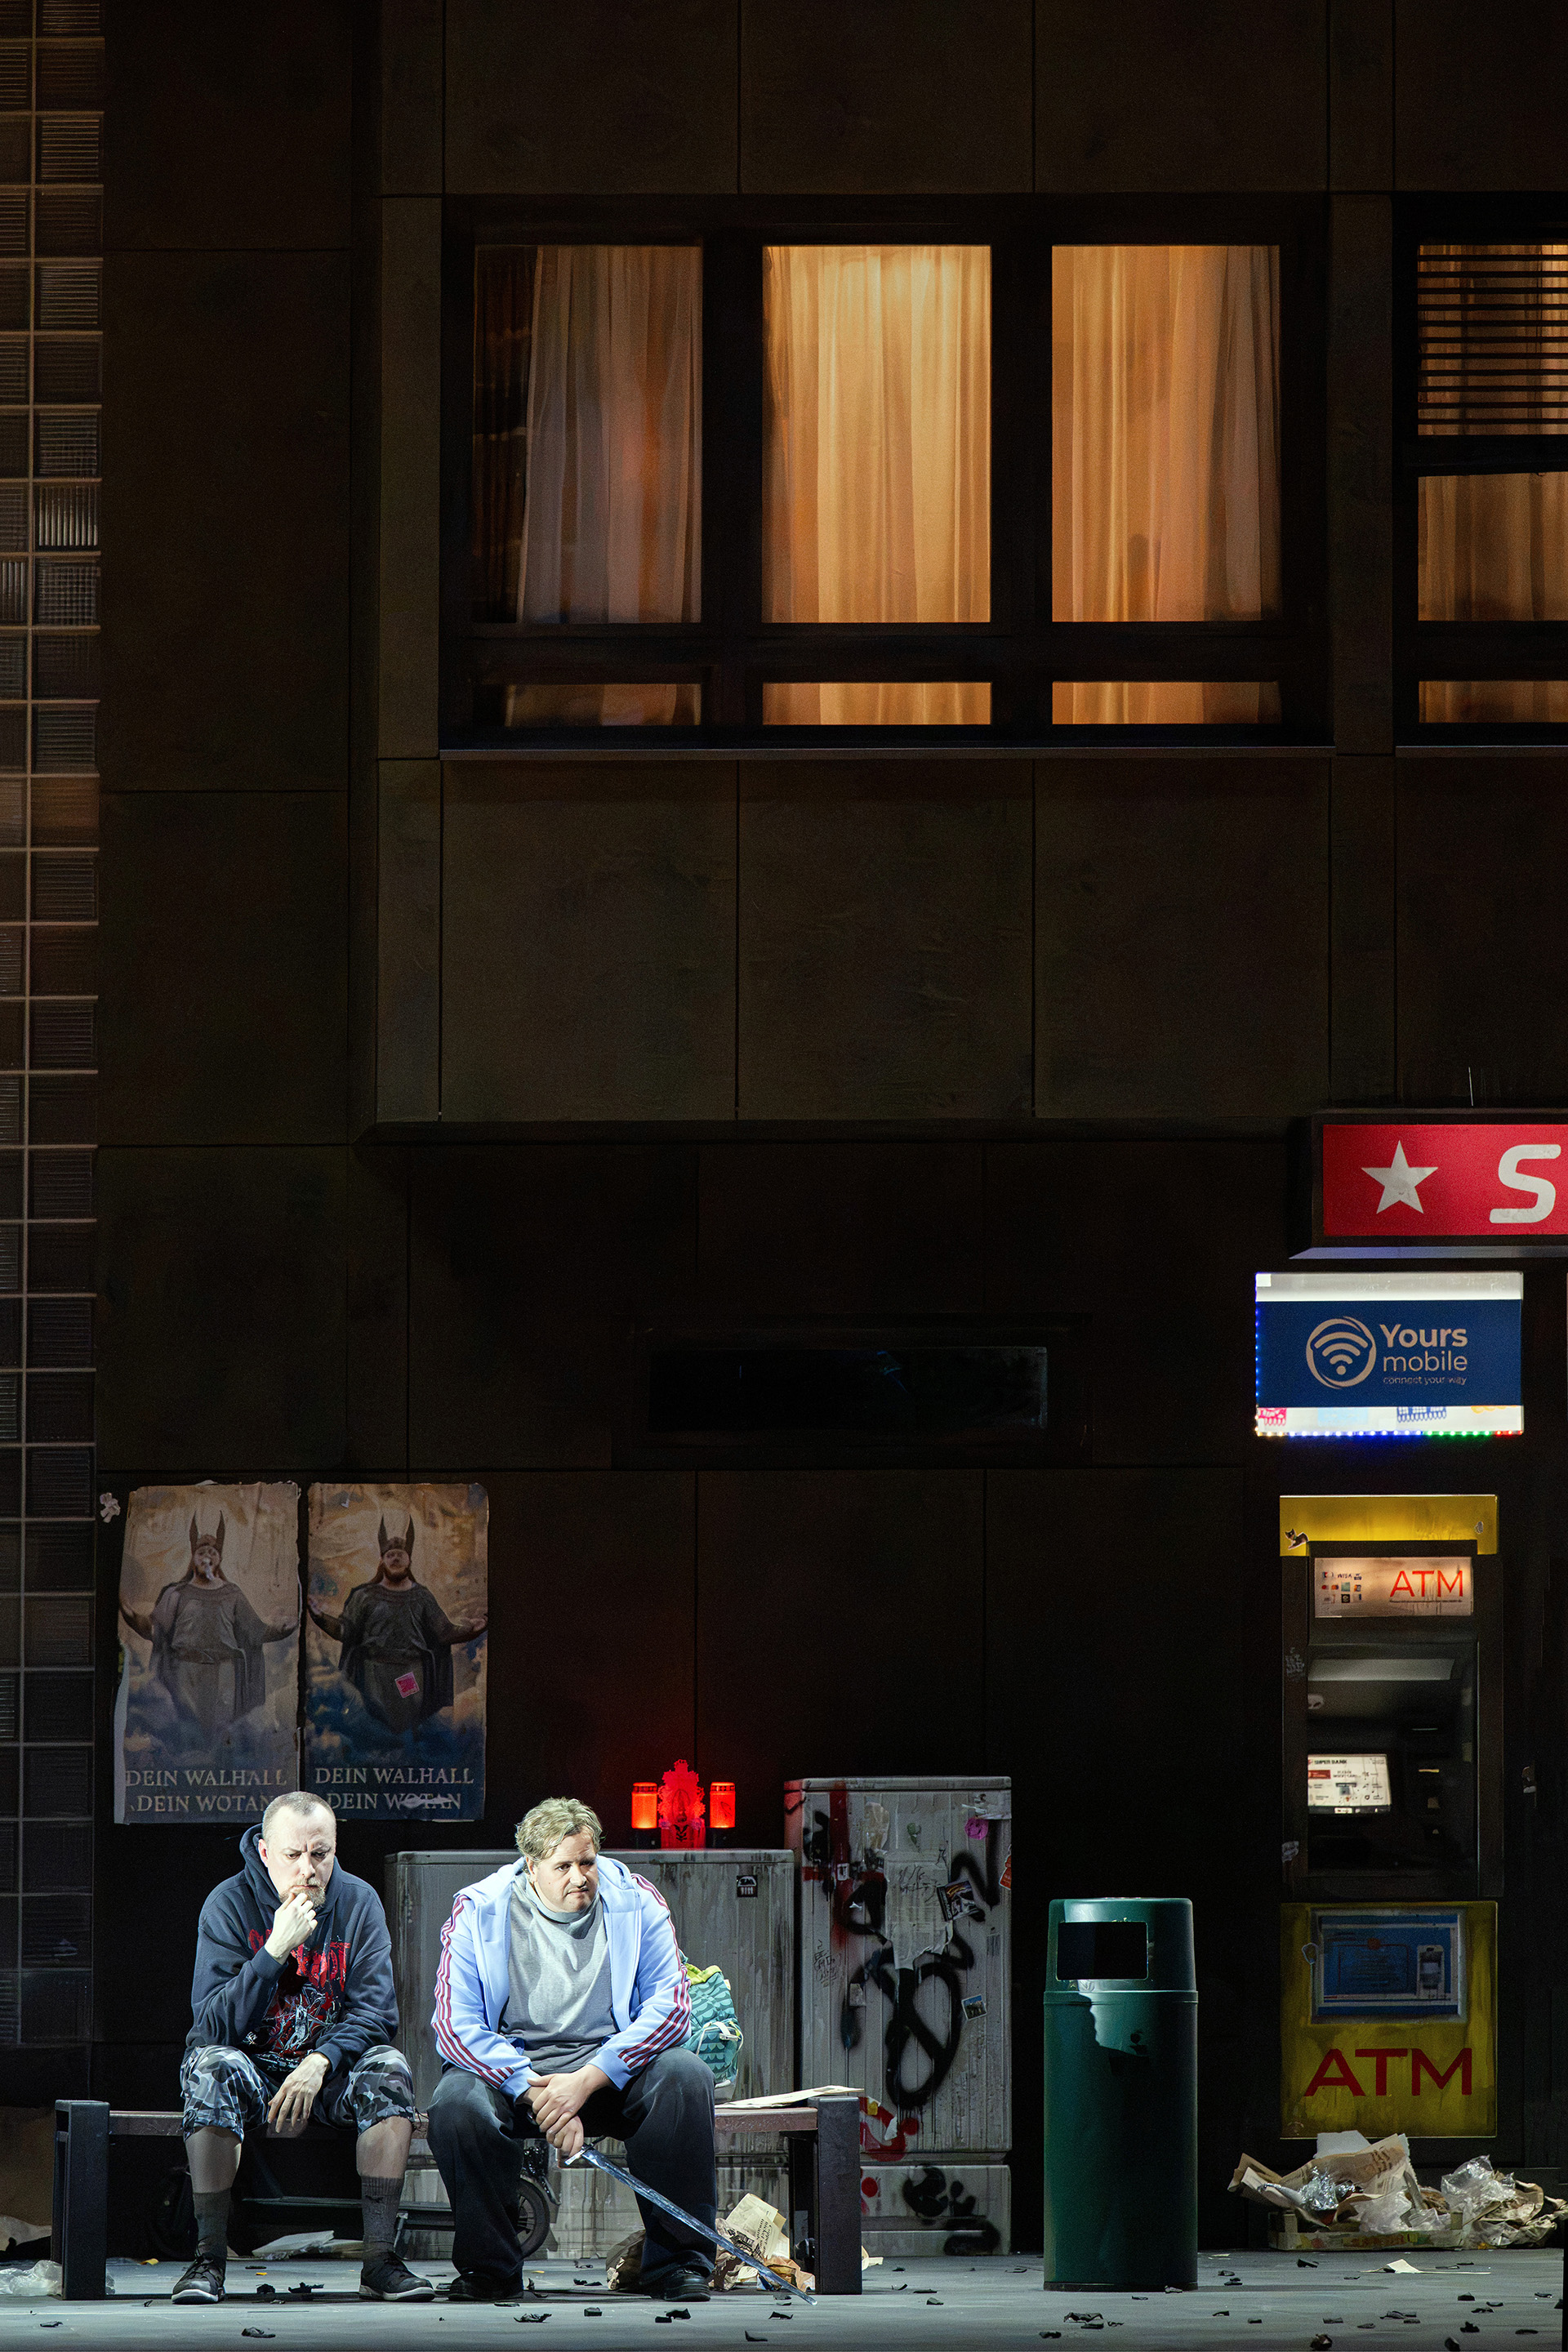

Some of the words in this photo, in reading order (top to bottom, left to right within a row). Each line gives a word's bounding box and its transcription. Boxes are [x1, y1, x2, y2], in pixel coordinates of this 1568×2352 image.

[1489, 1144, 1561, 1223] S
[1379, 1324, 1468, 1348] Yours
[1383, 1350, 1468, 1372] mobile
[1383, 1376, 1423, 1384] connect
[1423, 1376, 1446, 1386] your
[1449, 1376, 1468, 1386] way
[1389, 1570, 1463, 1597] ATM
[126, 1770, 178, 1787] DEIN
[185, 1769, 287, 1787] WALHALL
[316, 1767, 367, 1784] DEIN
[372, 1767, 474, 1784] WALHALL
[136, 1795, 190, 1812] DEIN
[327, 1793, 378, 1810] DEIN
[1303, 2047, 1472, 2097] ATM
